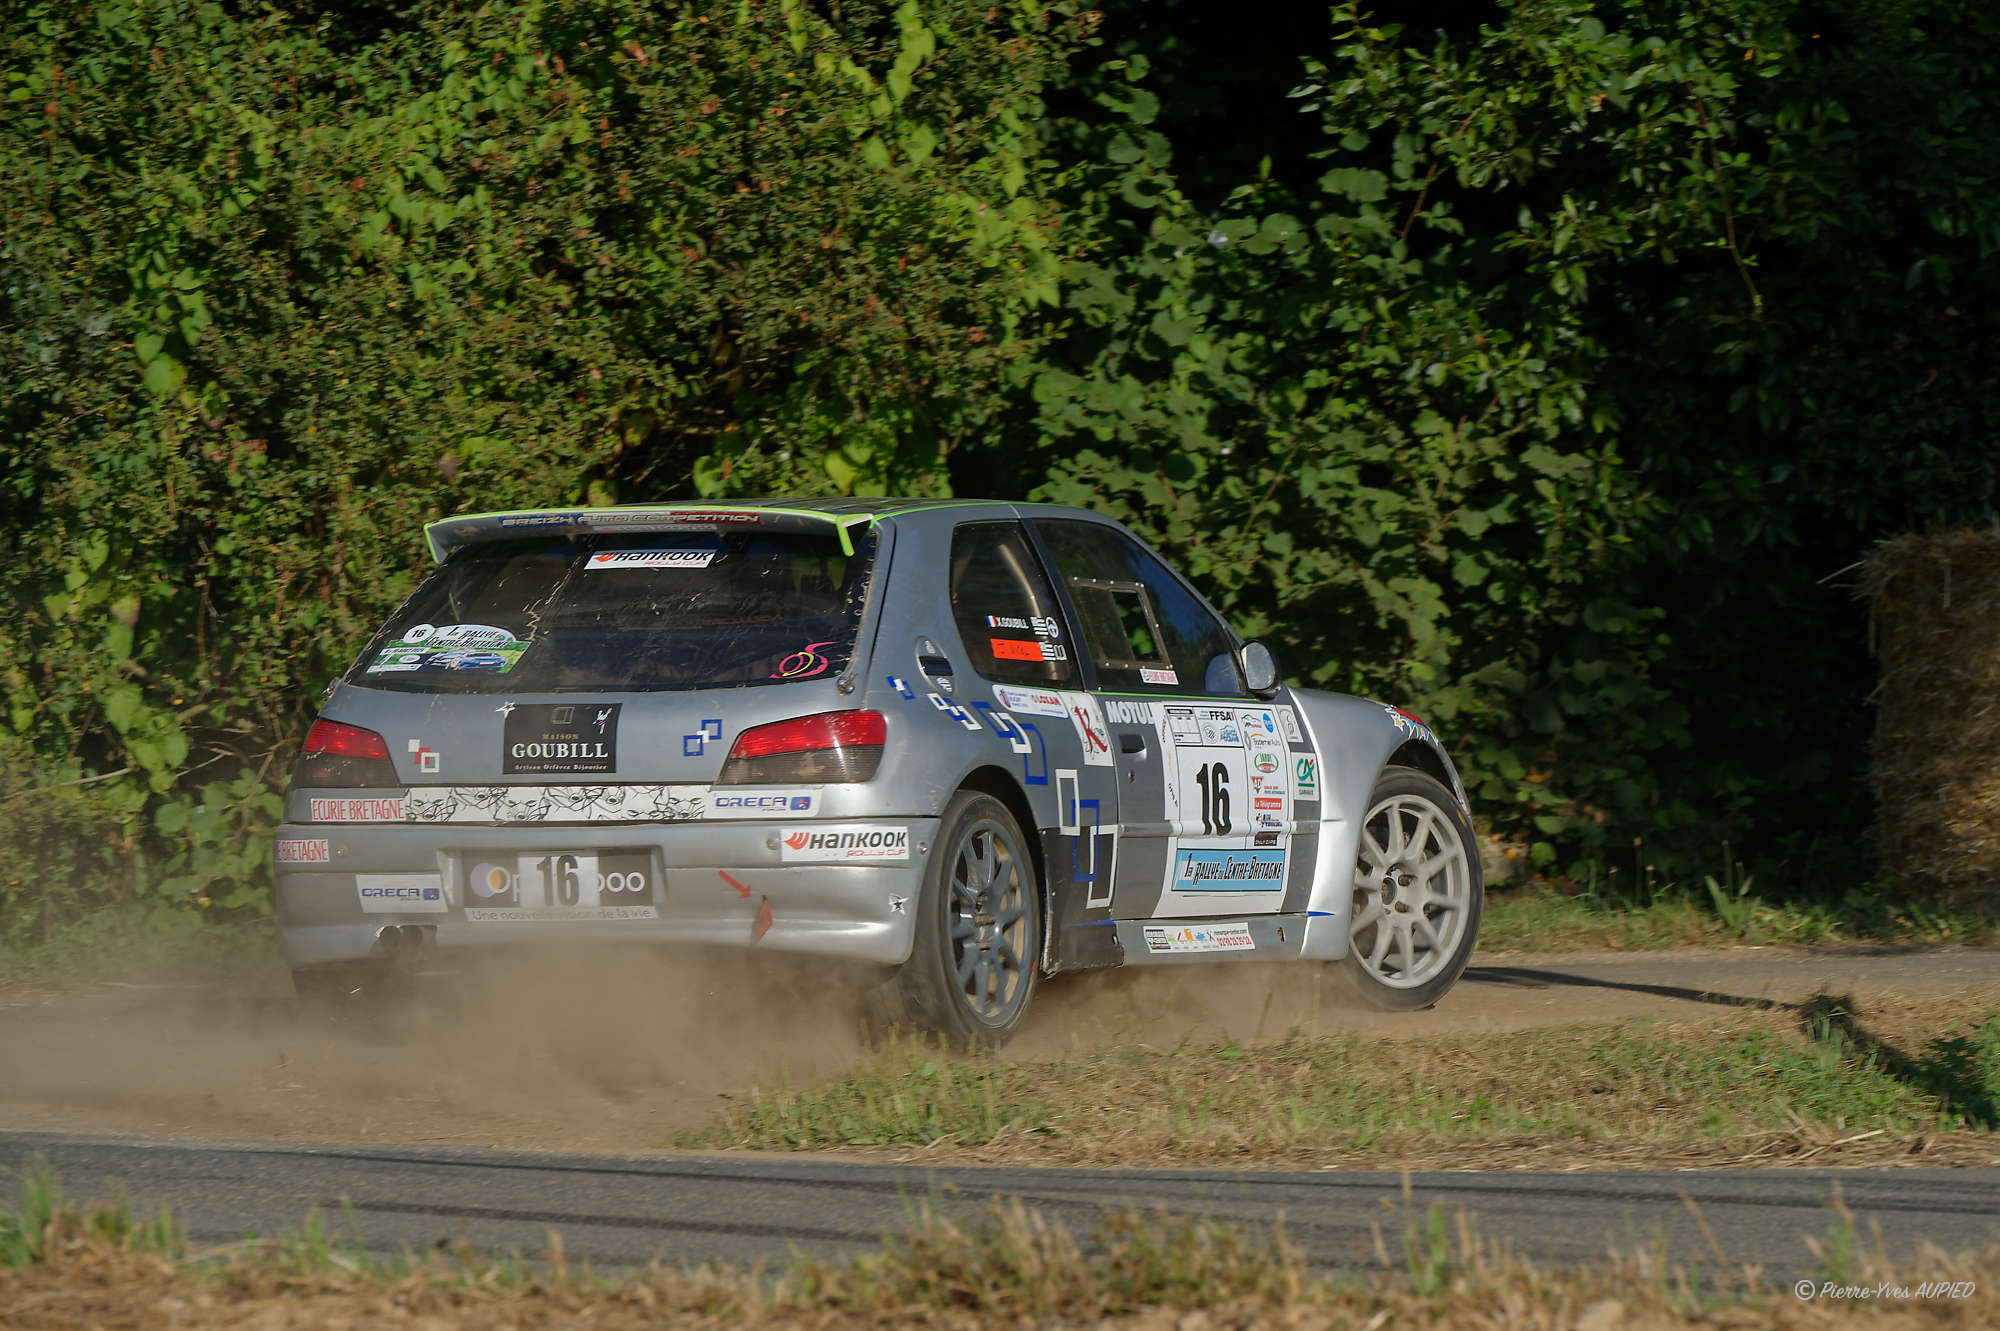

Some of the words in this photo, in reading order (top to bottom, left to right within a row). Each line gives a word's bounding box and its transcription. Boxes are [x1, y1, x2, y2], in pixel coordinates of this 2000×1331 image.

[411, 629, 426, 638] 16
[1105, 701, 1156, 725] MOTUL
[1209, 711, 1232, 720] FFSA
[511, 743, 609, 758] GOUBILL
[312, 799, 347, 820] ECURIE
[349, 799, 405, 820] BRETAGNE
[715, 796, 787, 807] ORECA
[1196, 762, 1232, 836] 16
[281, 840, 329, 861] BRETAGNE
[536, 855, 580, 906] 16
[1192, 862, 1220, 886] RALLYE
[361, 887, 420, 897] ORECA
